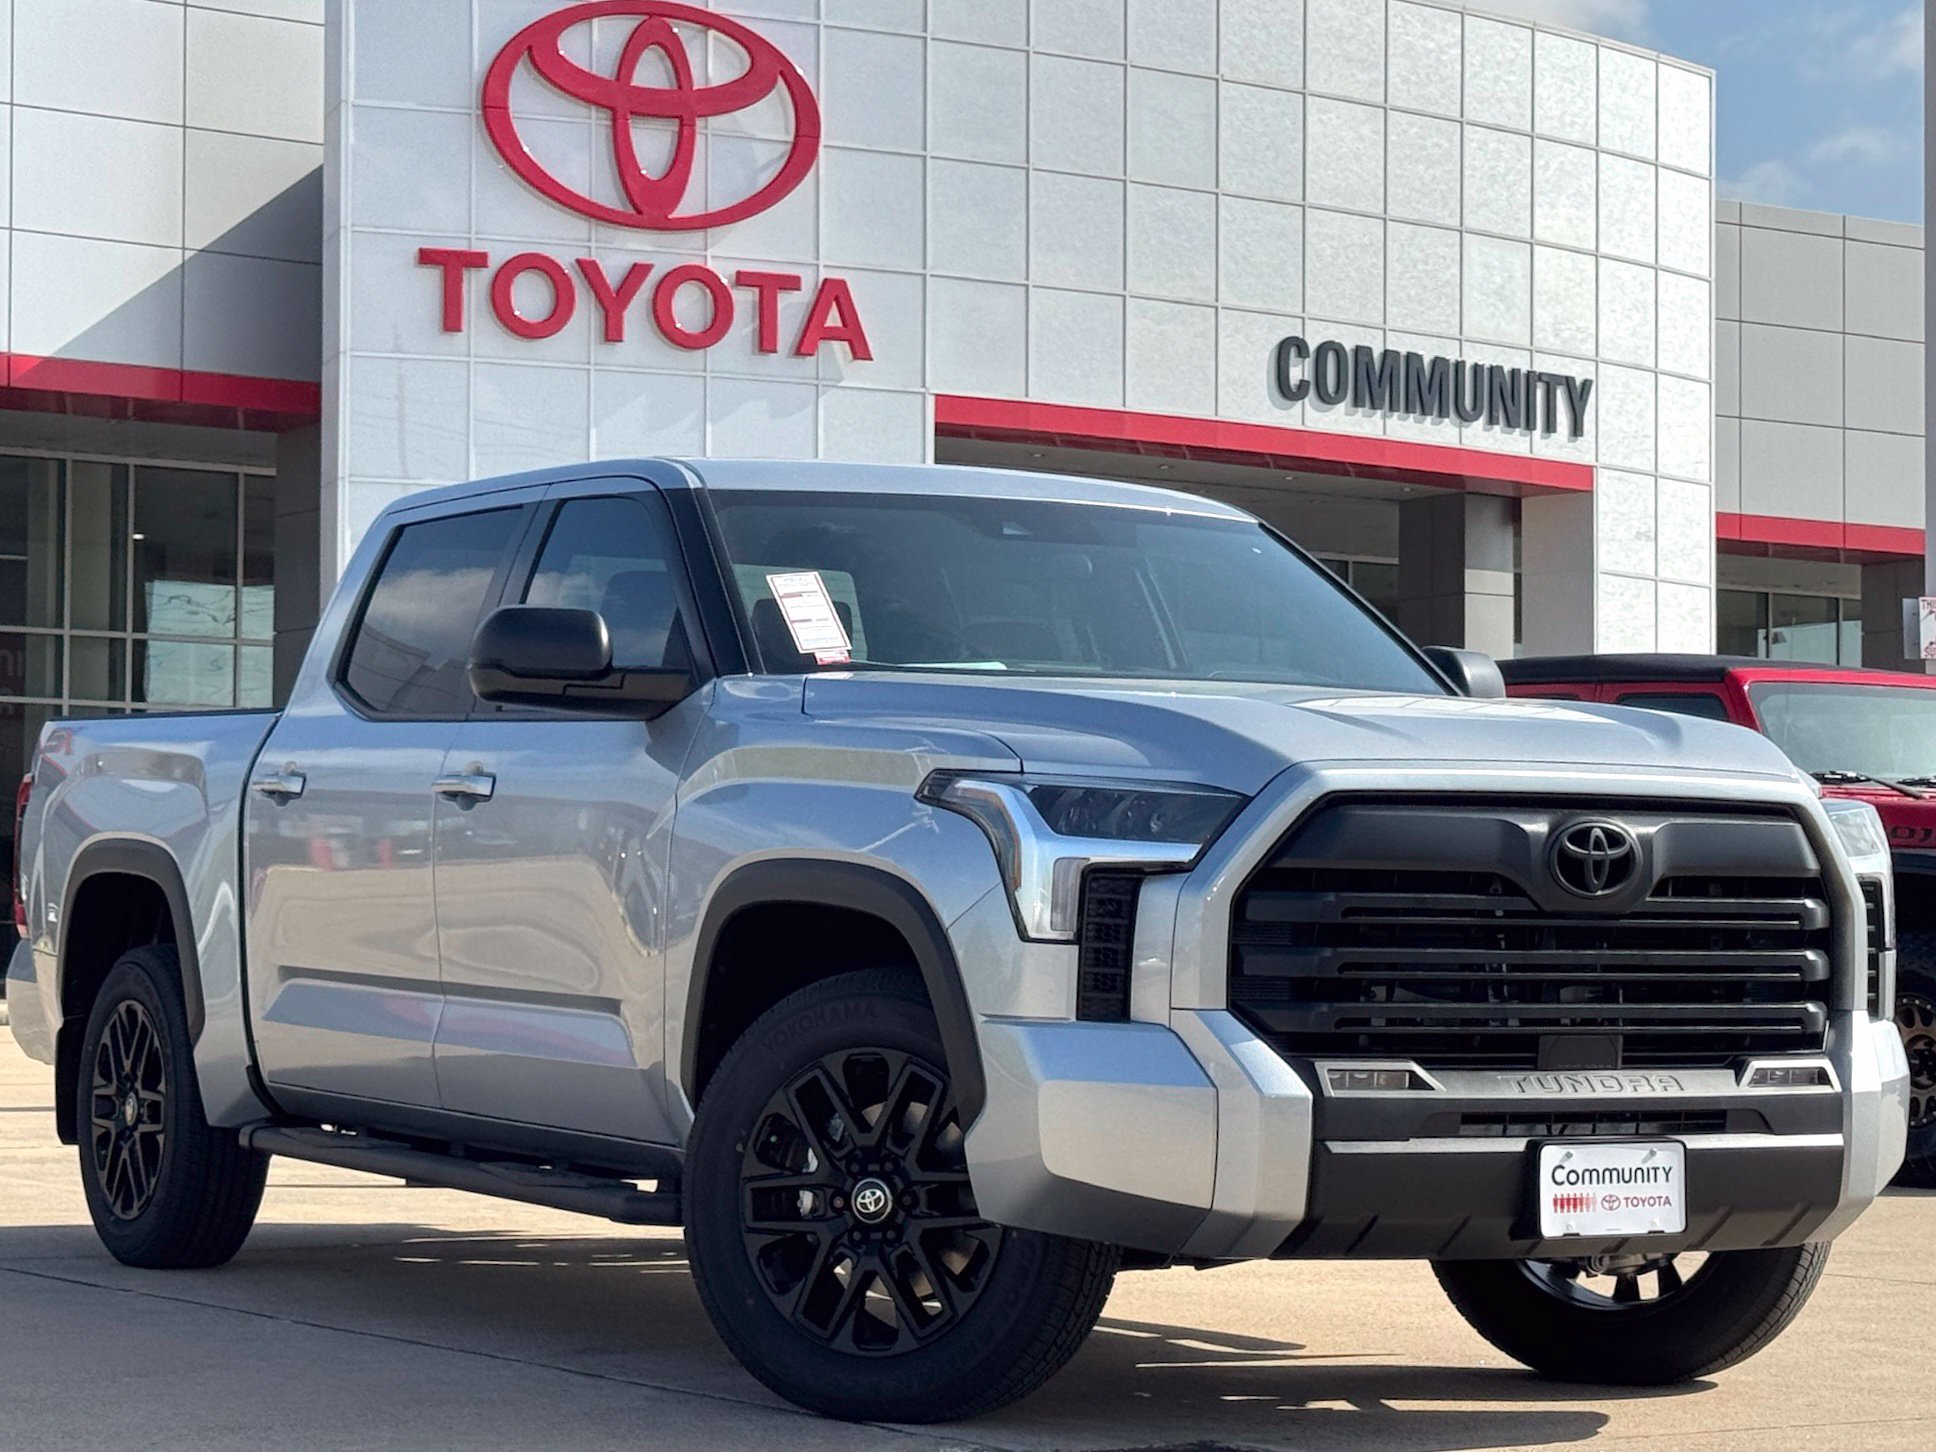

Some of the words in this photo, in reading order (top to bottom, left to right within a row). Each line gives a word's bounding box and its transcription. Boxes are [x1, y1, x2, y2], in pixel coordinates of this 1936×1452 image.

[418, 247, 874, 361] TOYOTA
[1276, 336, 1594, 438] COMMUNITY
[761, 1001, 880, 1052] YOKOHAMA
[1497, 1074, 1685, 1094] TUNDRA
[1623, 1195, 1673, 1208] TOYOTA
